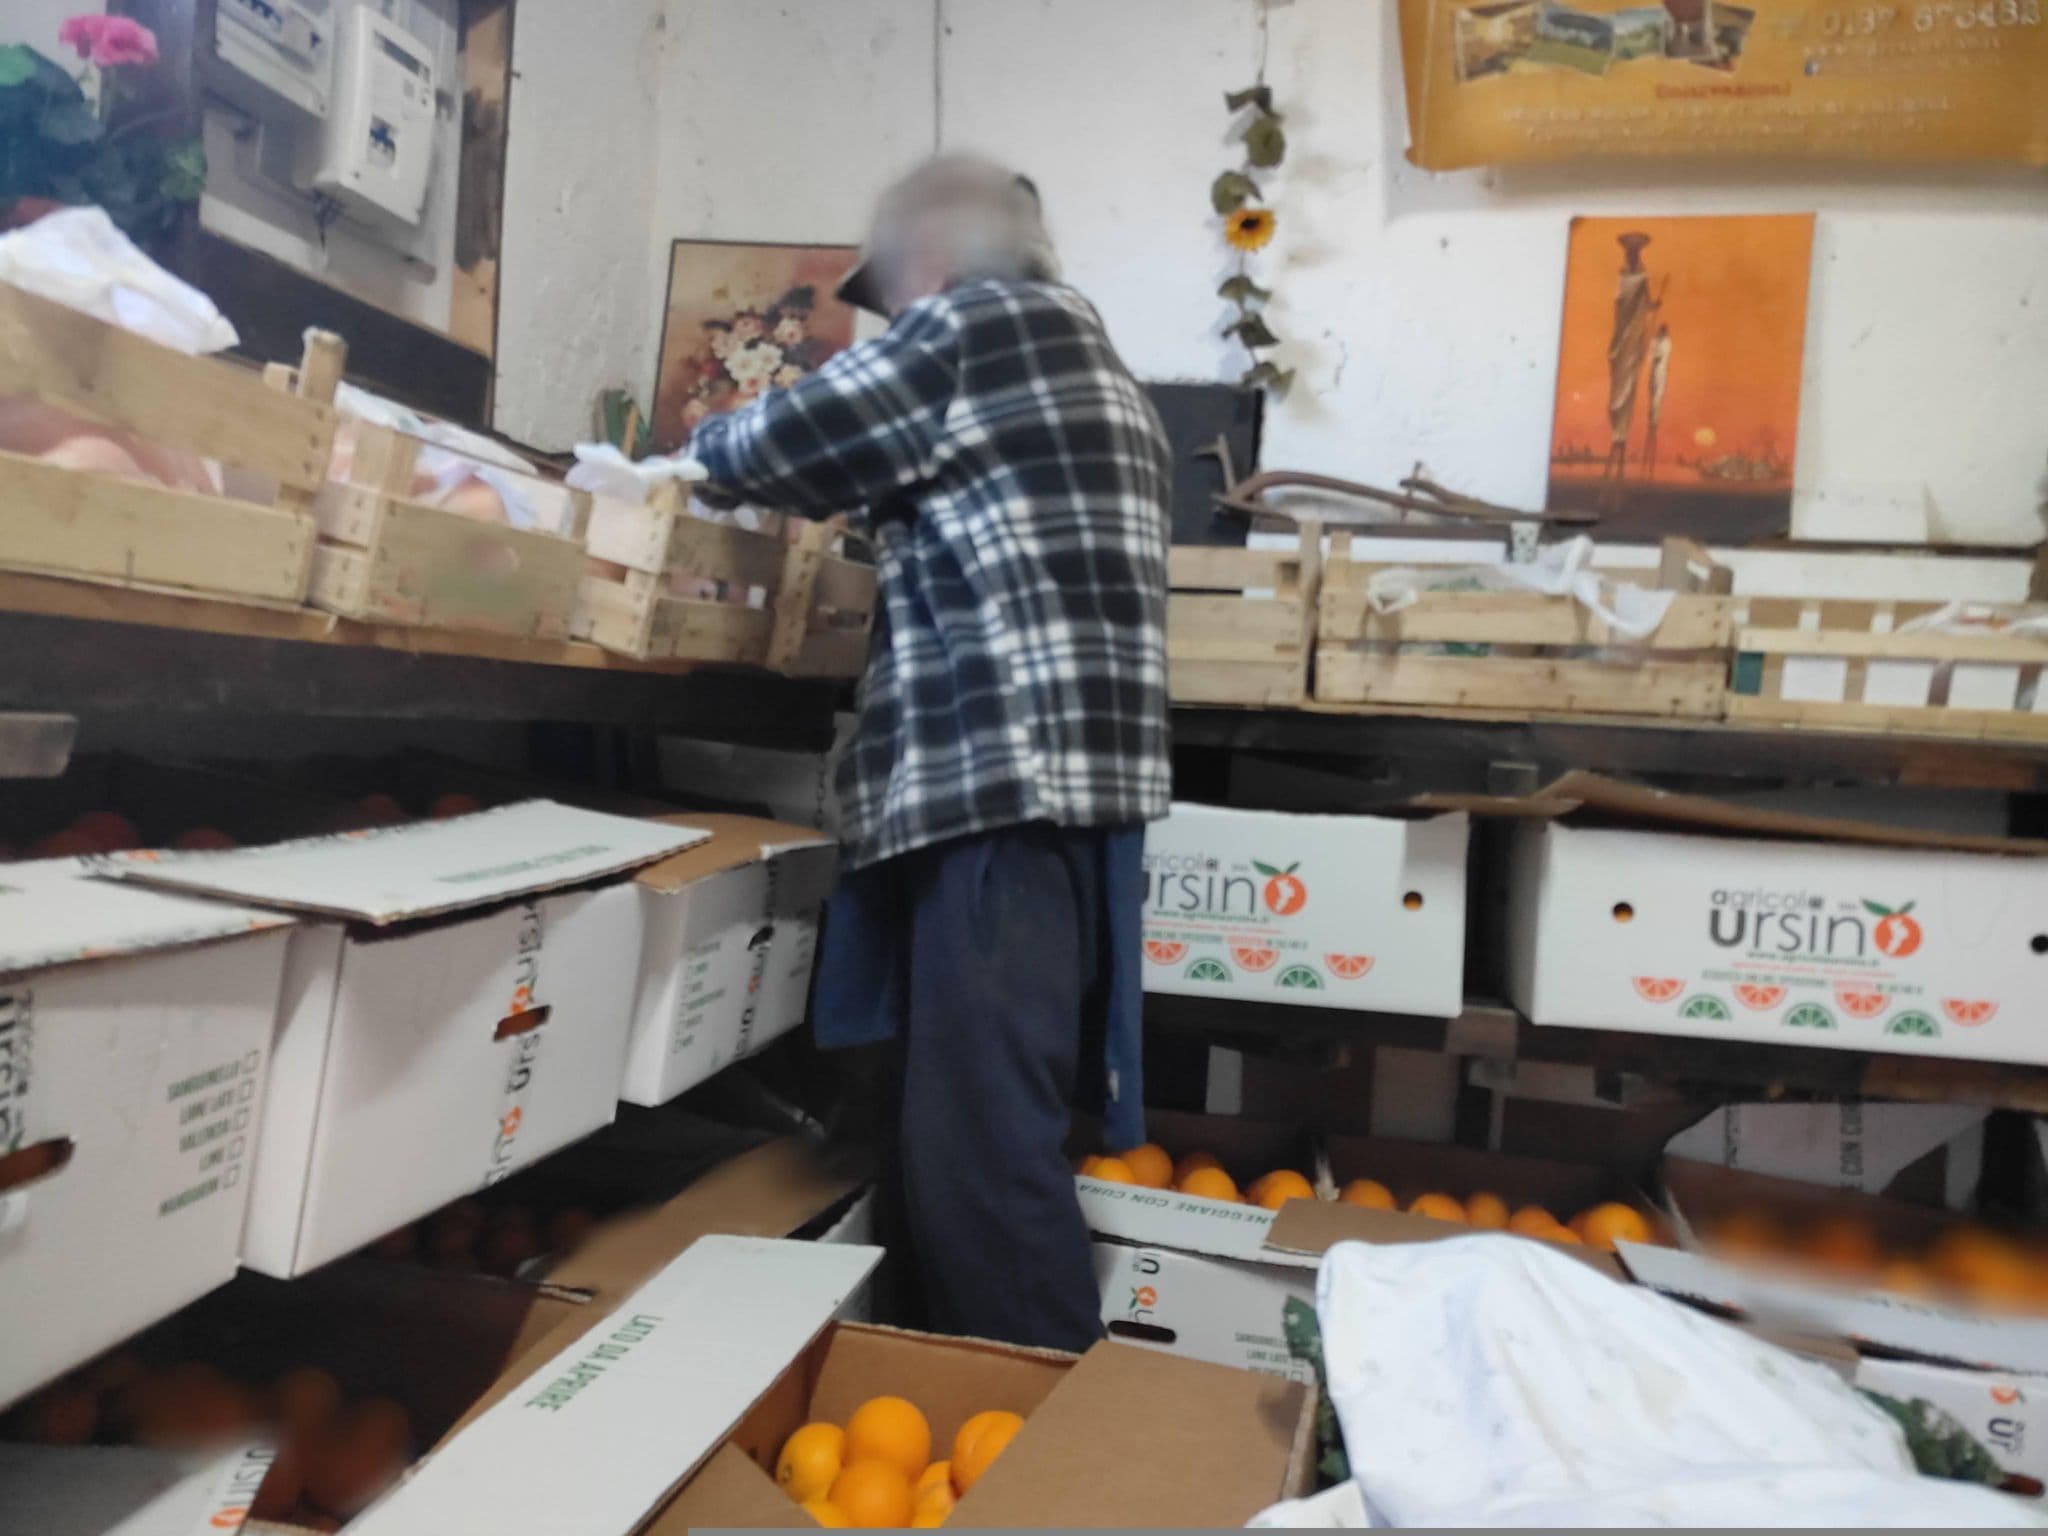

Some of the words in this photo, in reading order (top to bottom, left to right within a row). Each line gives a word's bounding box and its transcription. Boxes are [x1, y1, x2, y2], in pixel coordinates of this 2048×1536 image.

[1078, 1184, 1129, 1200] CURA
[1132, 1193, 1170, 1208] CON
[585, 1344, 630, 1360] DA
